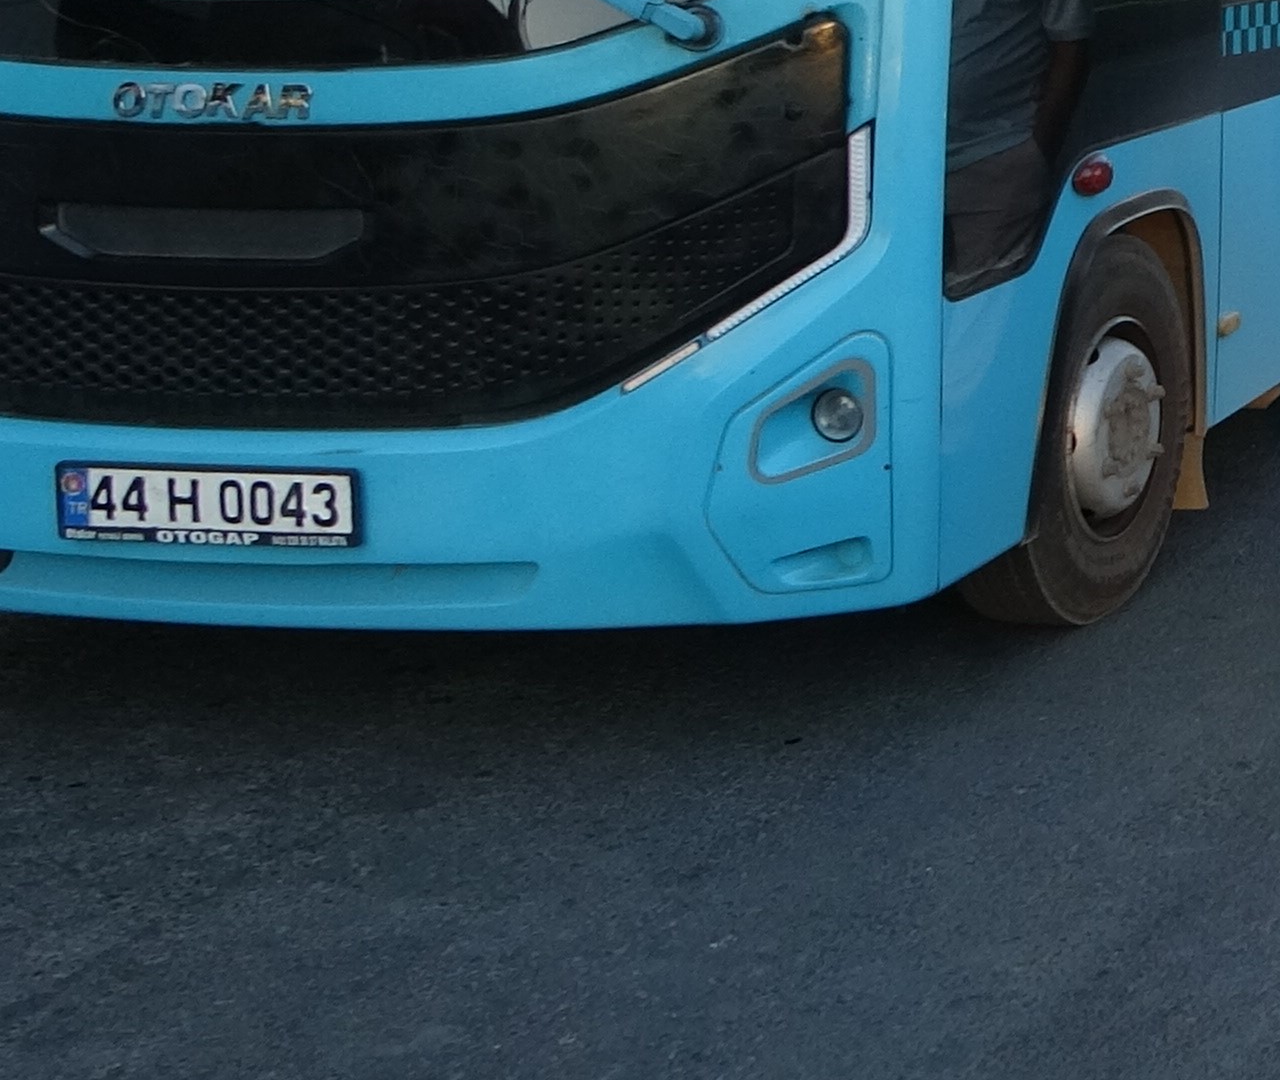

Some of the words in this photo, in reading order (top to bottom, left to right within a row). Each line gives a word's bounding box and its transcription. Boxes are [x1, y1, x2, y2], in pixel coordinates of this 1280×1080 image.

[113, 81, 314, 121] OTOKAR
[91, 475, 149, 522] 44
[167, 478, 201, 523] H
[219, 479, 339, 528] 0043
[156, 529, 260, 546] OTOGAP
